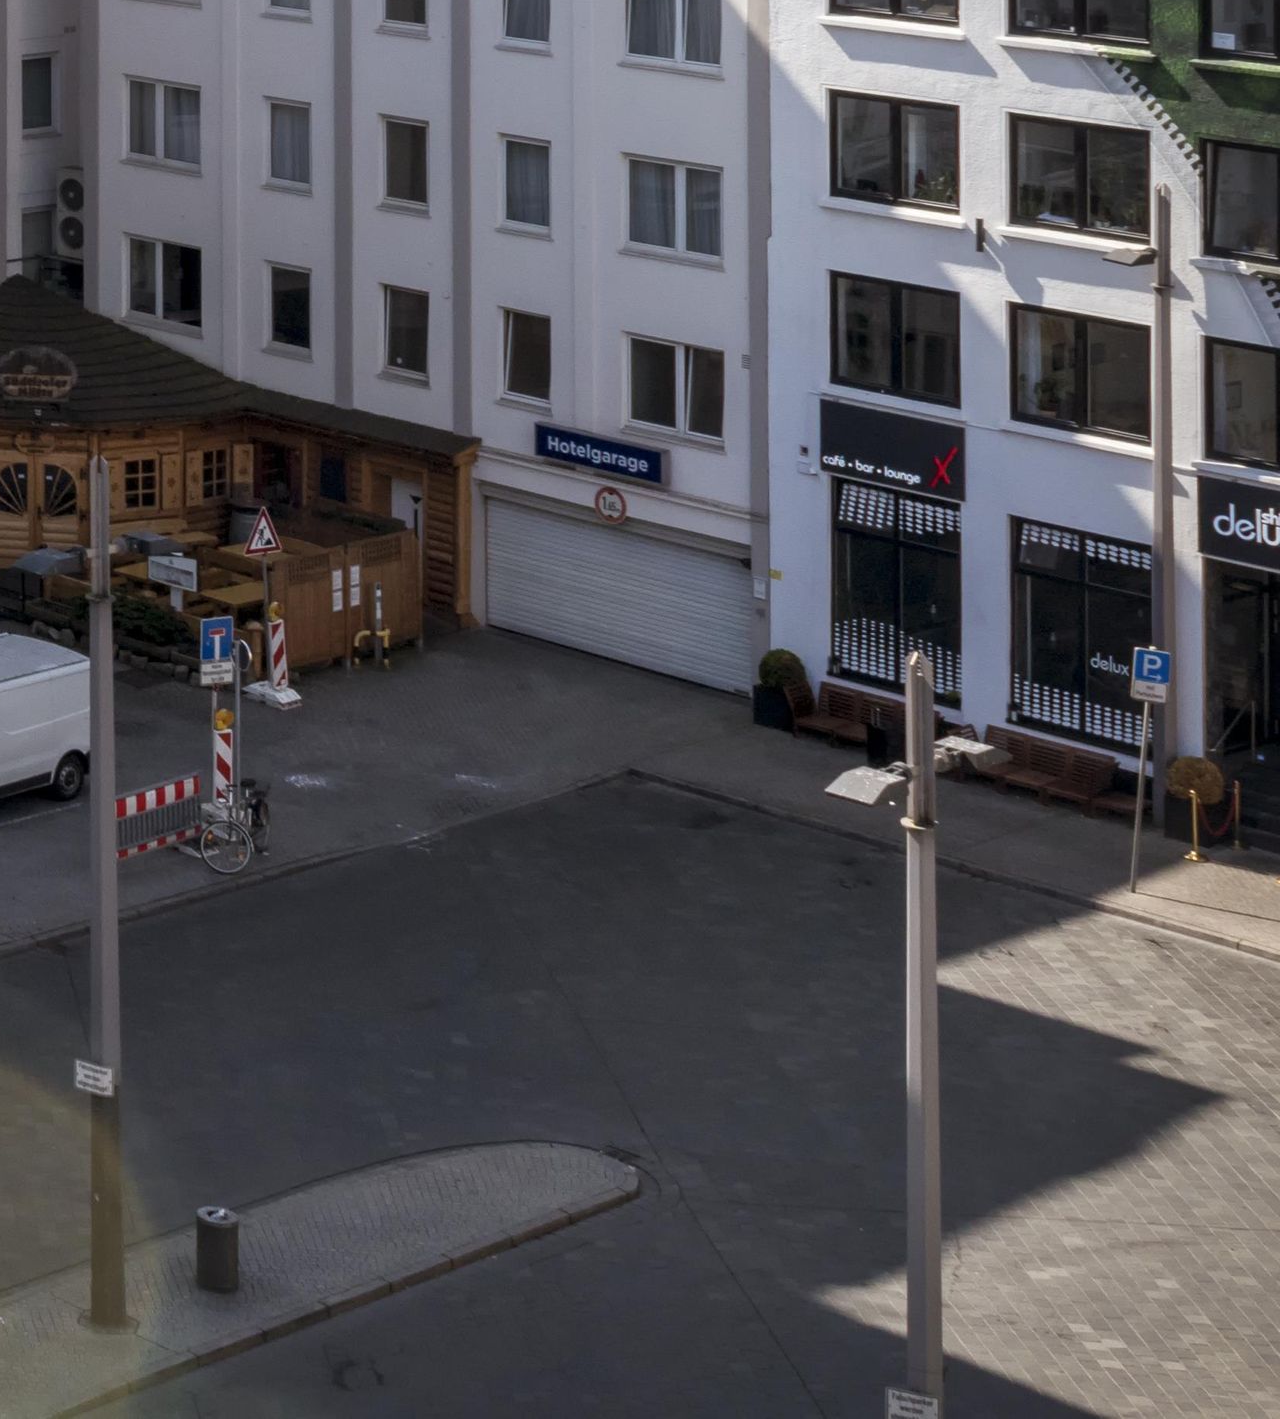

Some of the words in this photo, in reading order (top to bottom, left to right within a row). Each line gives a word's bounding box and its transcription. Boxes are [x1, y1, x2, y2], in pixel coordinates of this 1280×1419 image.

[547, 436, 648, 472] Hotelgarage
[823, 455, 845, 467] café
[855, 460, 874, 474] bar
[884, 466, 921, 485] lounge
[1090, 652, 1130, 676] delux
[1143, 654, 1162, 676] P
